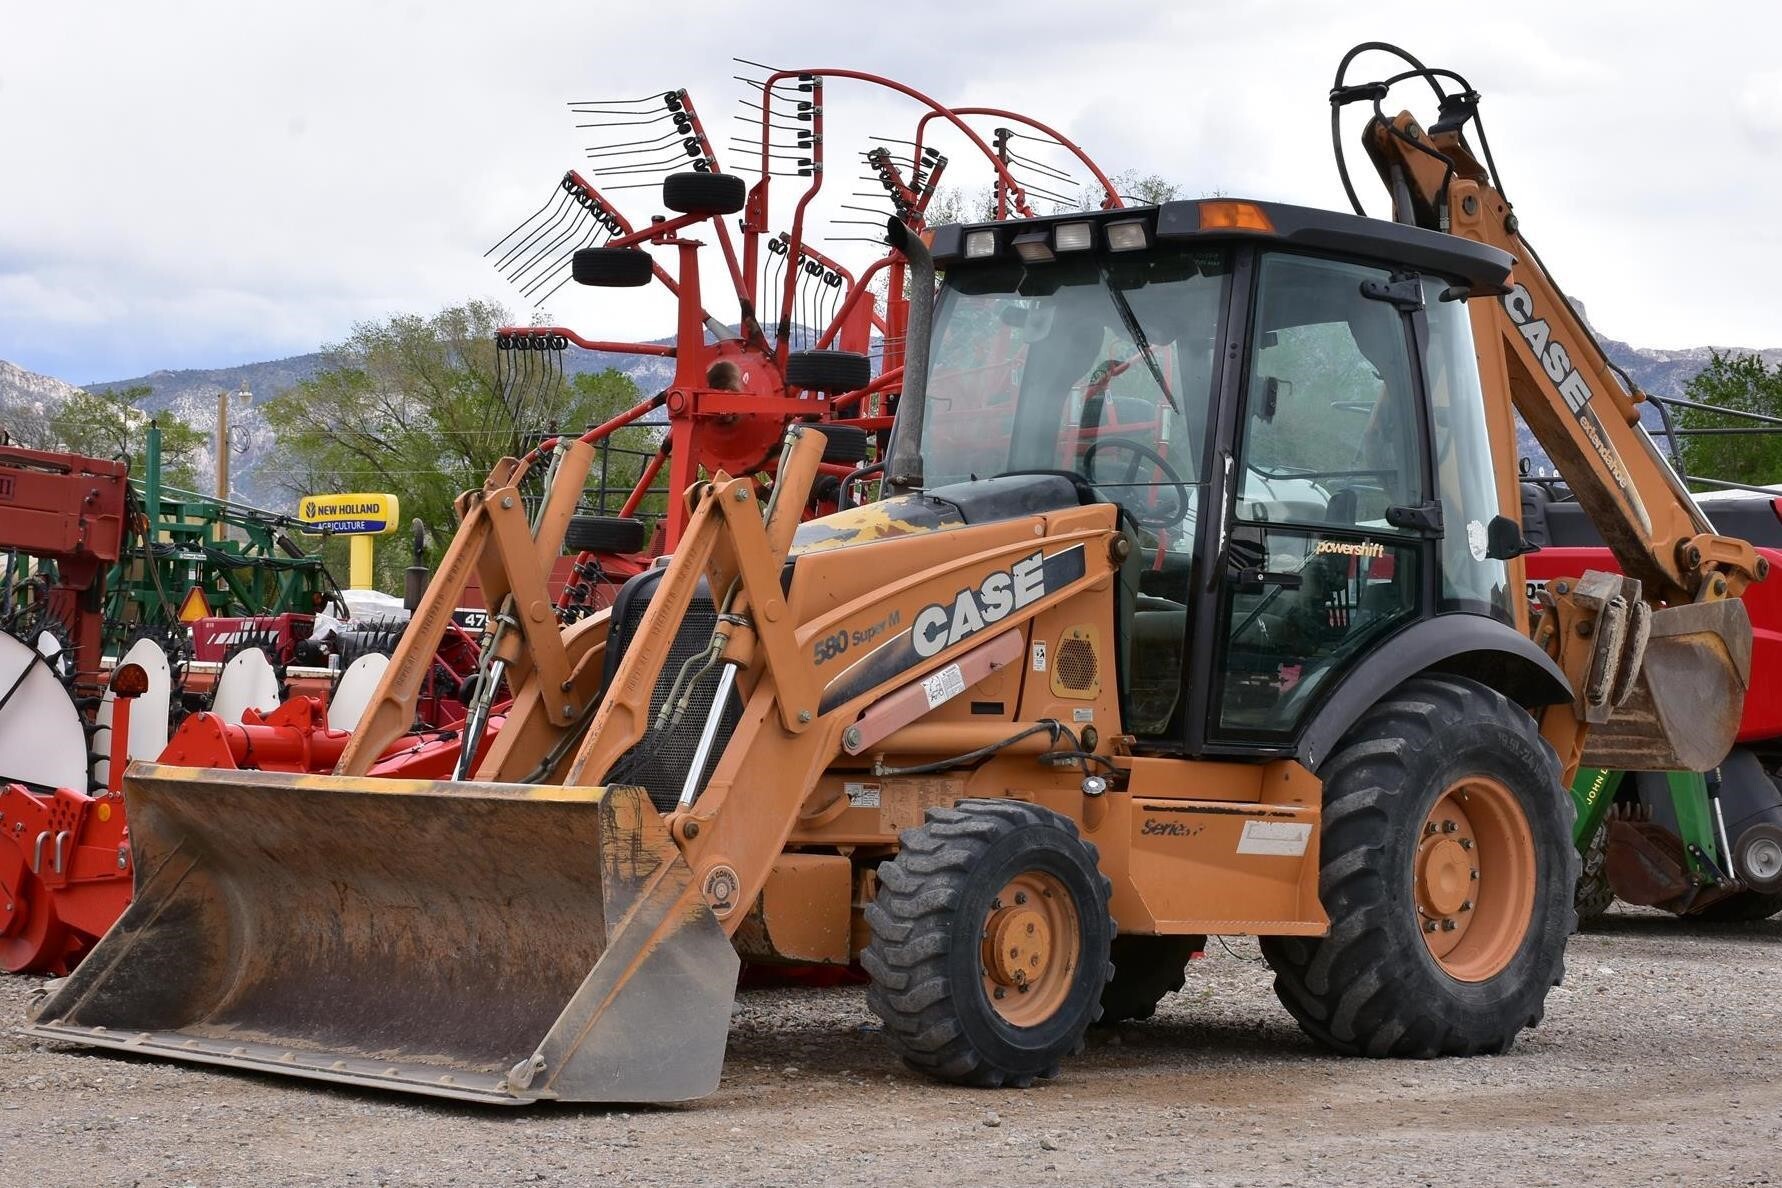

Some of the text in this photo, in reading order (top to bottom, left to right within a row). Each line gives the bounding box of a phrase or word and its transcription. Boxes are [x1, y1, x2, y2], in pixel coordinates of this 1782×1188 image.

[1505, 284, 1593, 413] CASE
[318, 503, 380, 515] NEW HOLLAND
[1315, 541, 1384, 558] powershift
[913, 551, 1045, 657] CASE
[814, 610, 901, 666] 580 Super M
[1586, 775, 1604, 805] JOHN
